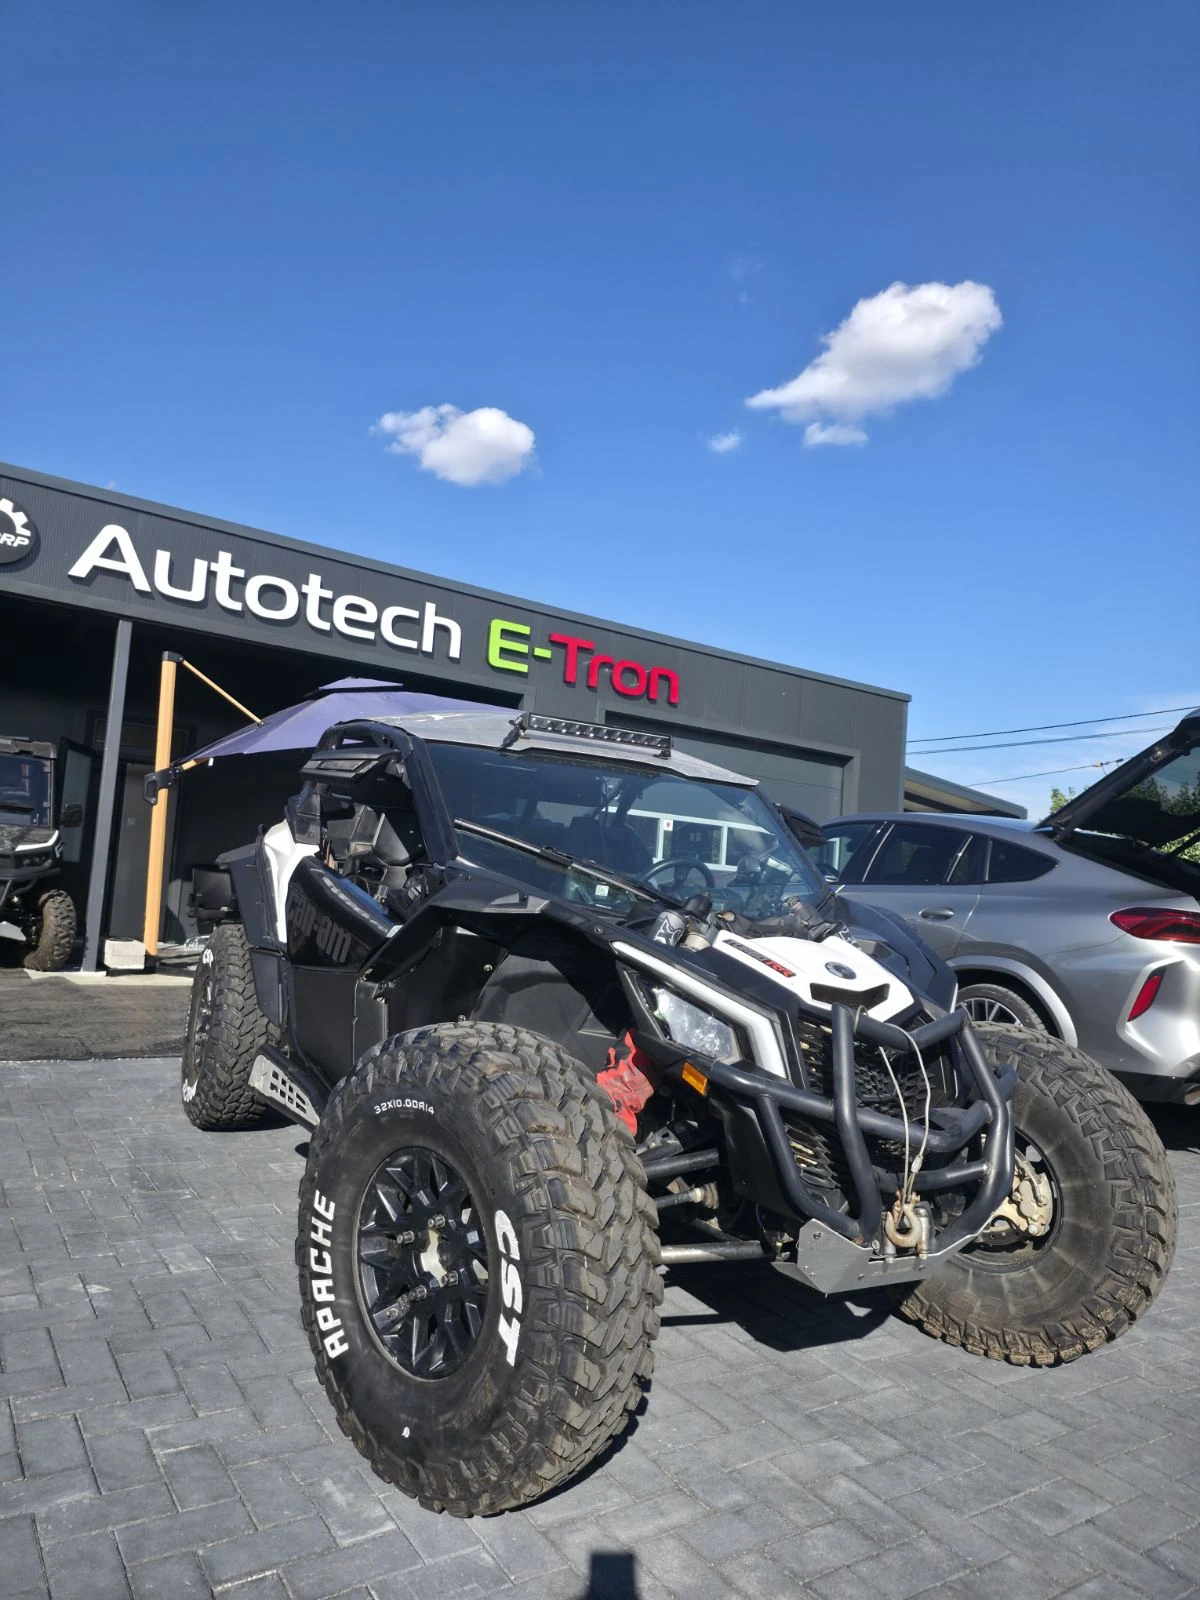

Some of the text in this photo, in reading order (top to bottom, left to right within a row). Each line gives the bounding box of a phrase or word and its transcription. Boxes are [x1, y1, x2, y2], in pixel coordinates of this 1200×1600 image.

[0, 533, 30, 548] RP
[68, 523, 681, 705] Autotech E-Tron
[310, 1190, 349, 1358] APACHE
[495, 1210, 523, 1367] CST
